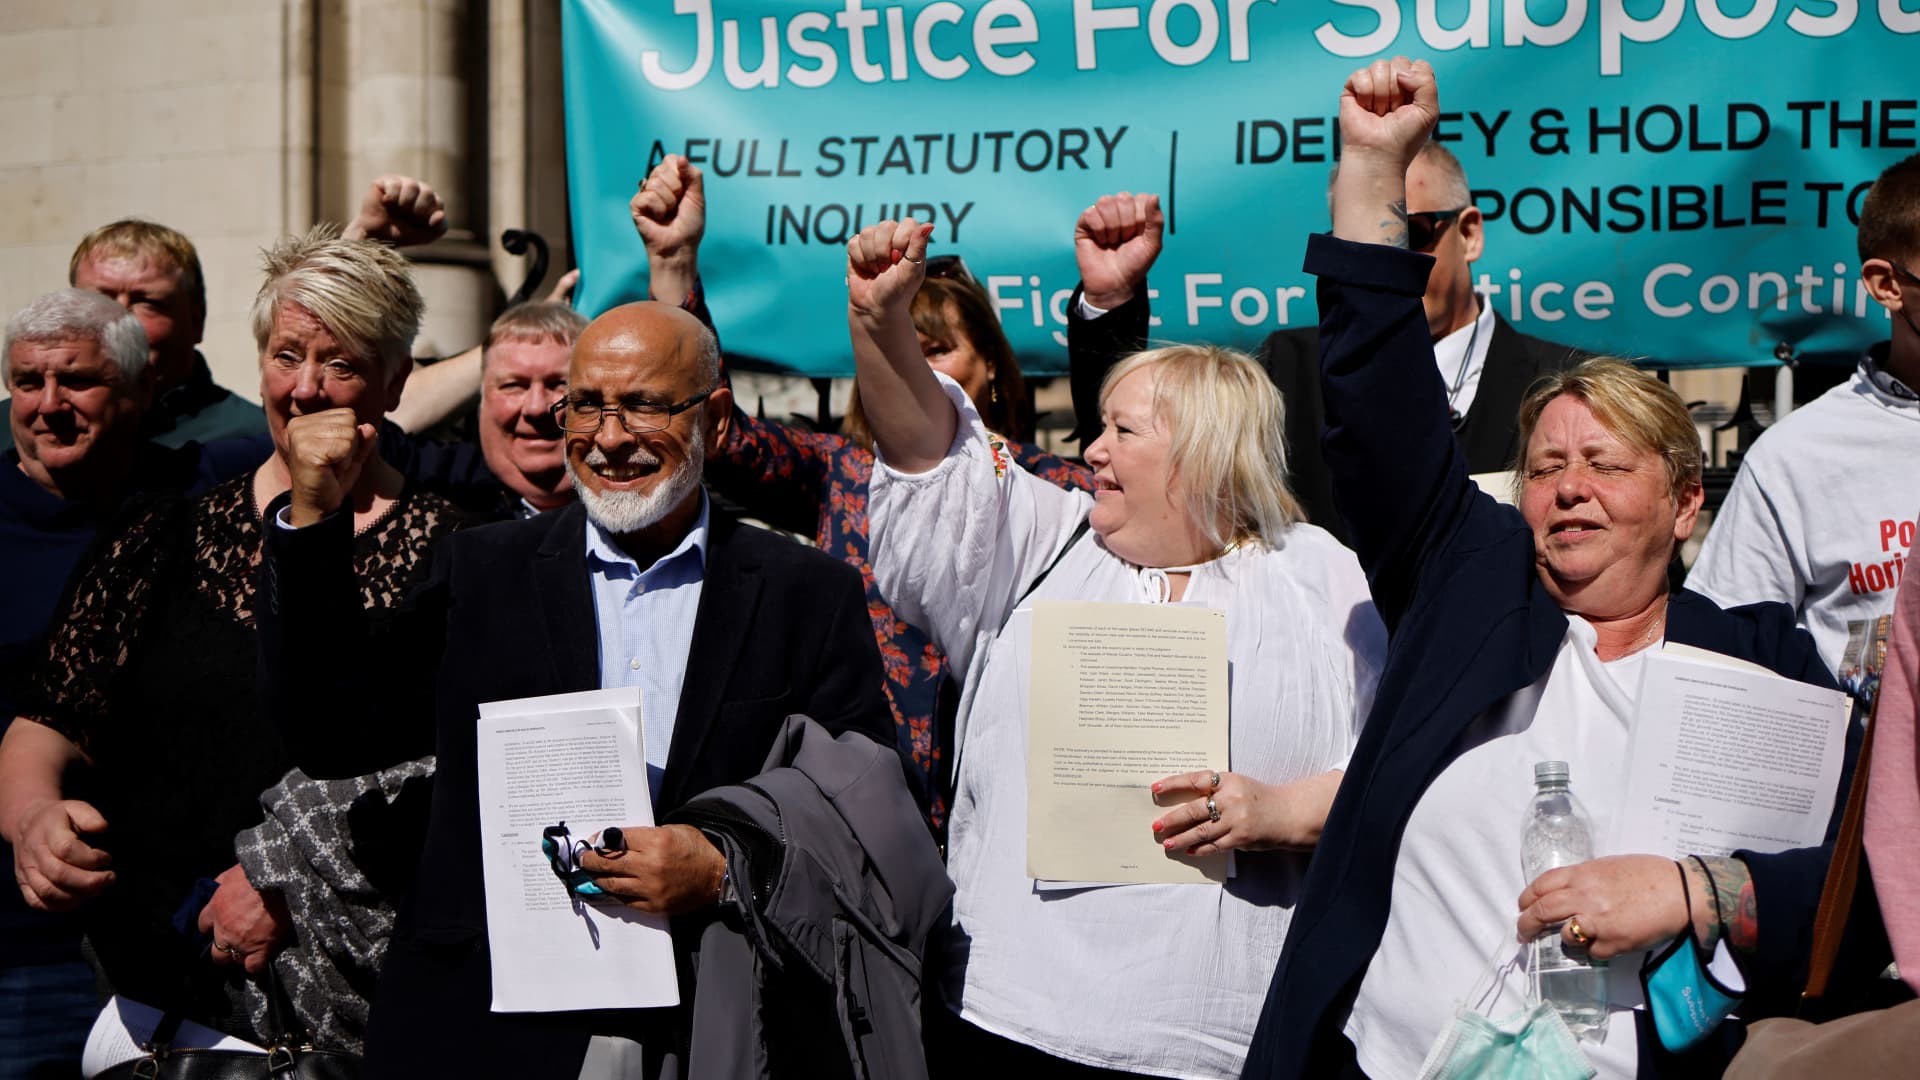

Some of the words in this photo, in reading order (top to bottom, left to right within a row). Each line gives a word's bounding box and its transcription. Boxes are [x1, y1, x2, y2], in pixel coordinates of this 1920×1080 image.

[640, 0, 1040, 91] Justice
[1073, 0, 1278, 71] For
[684, 138, 803, 178] FULL
[814, 126, 1129, 178] STATUTORY
[1235, 110, 1511, 165] IDEFY
[1529, 108, 1570, 155] &
[1589, 103, 1771, 153] HOLD
[1786, 100, 1918, 149] THE
[1470, 180, 1788, 235] PONSIBLE
[1184, 273, 1307, 327] For
[1473, 267, 1615, 322] tice
[1848, 552, 1908, 595] Hori
